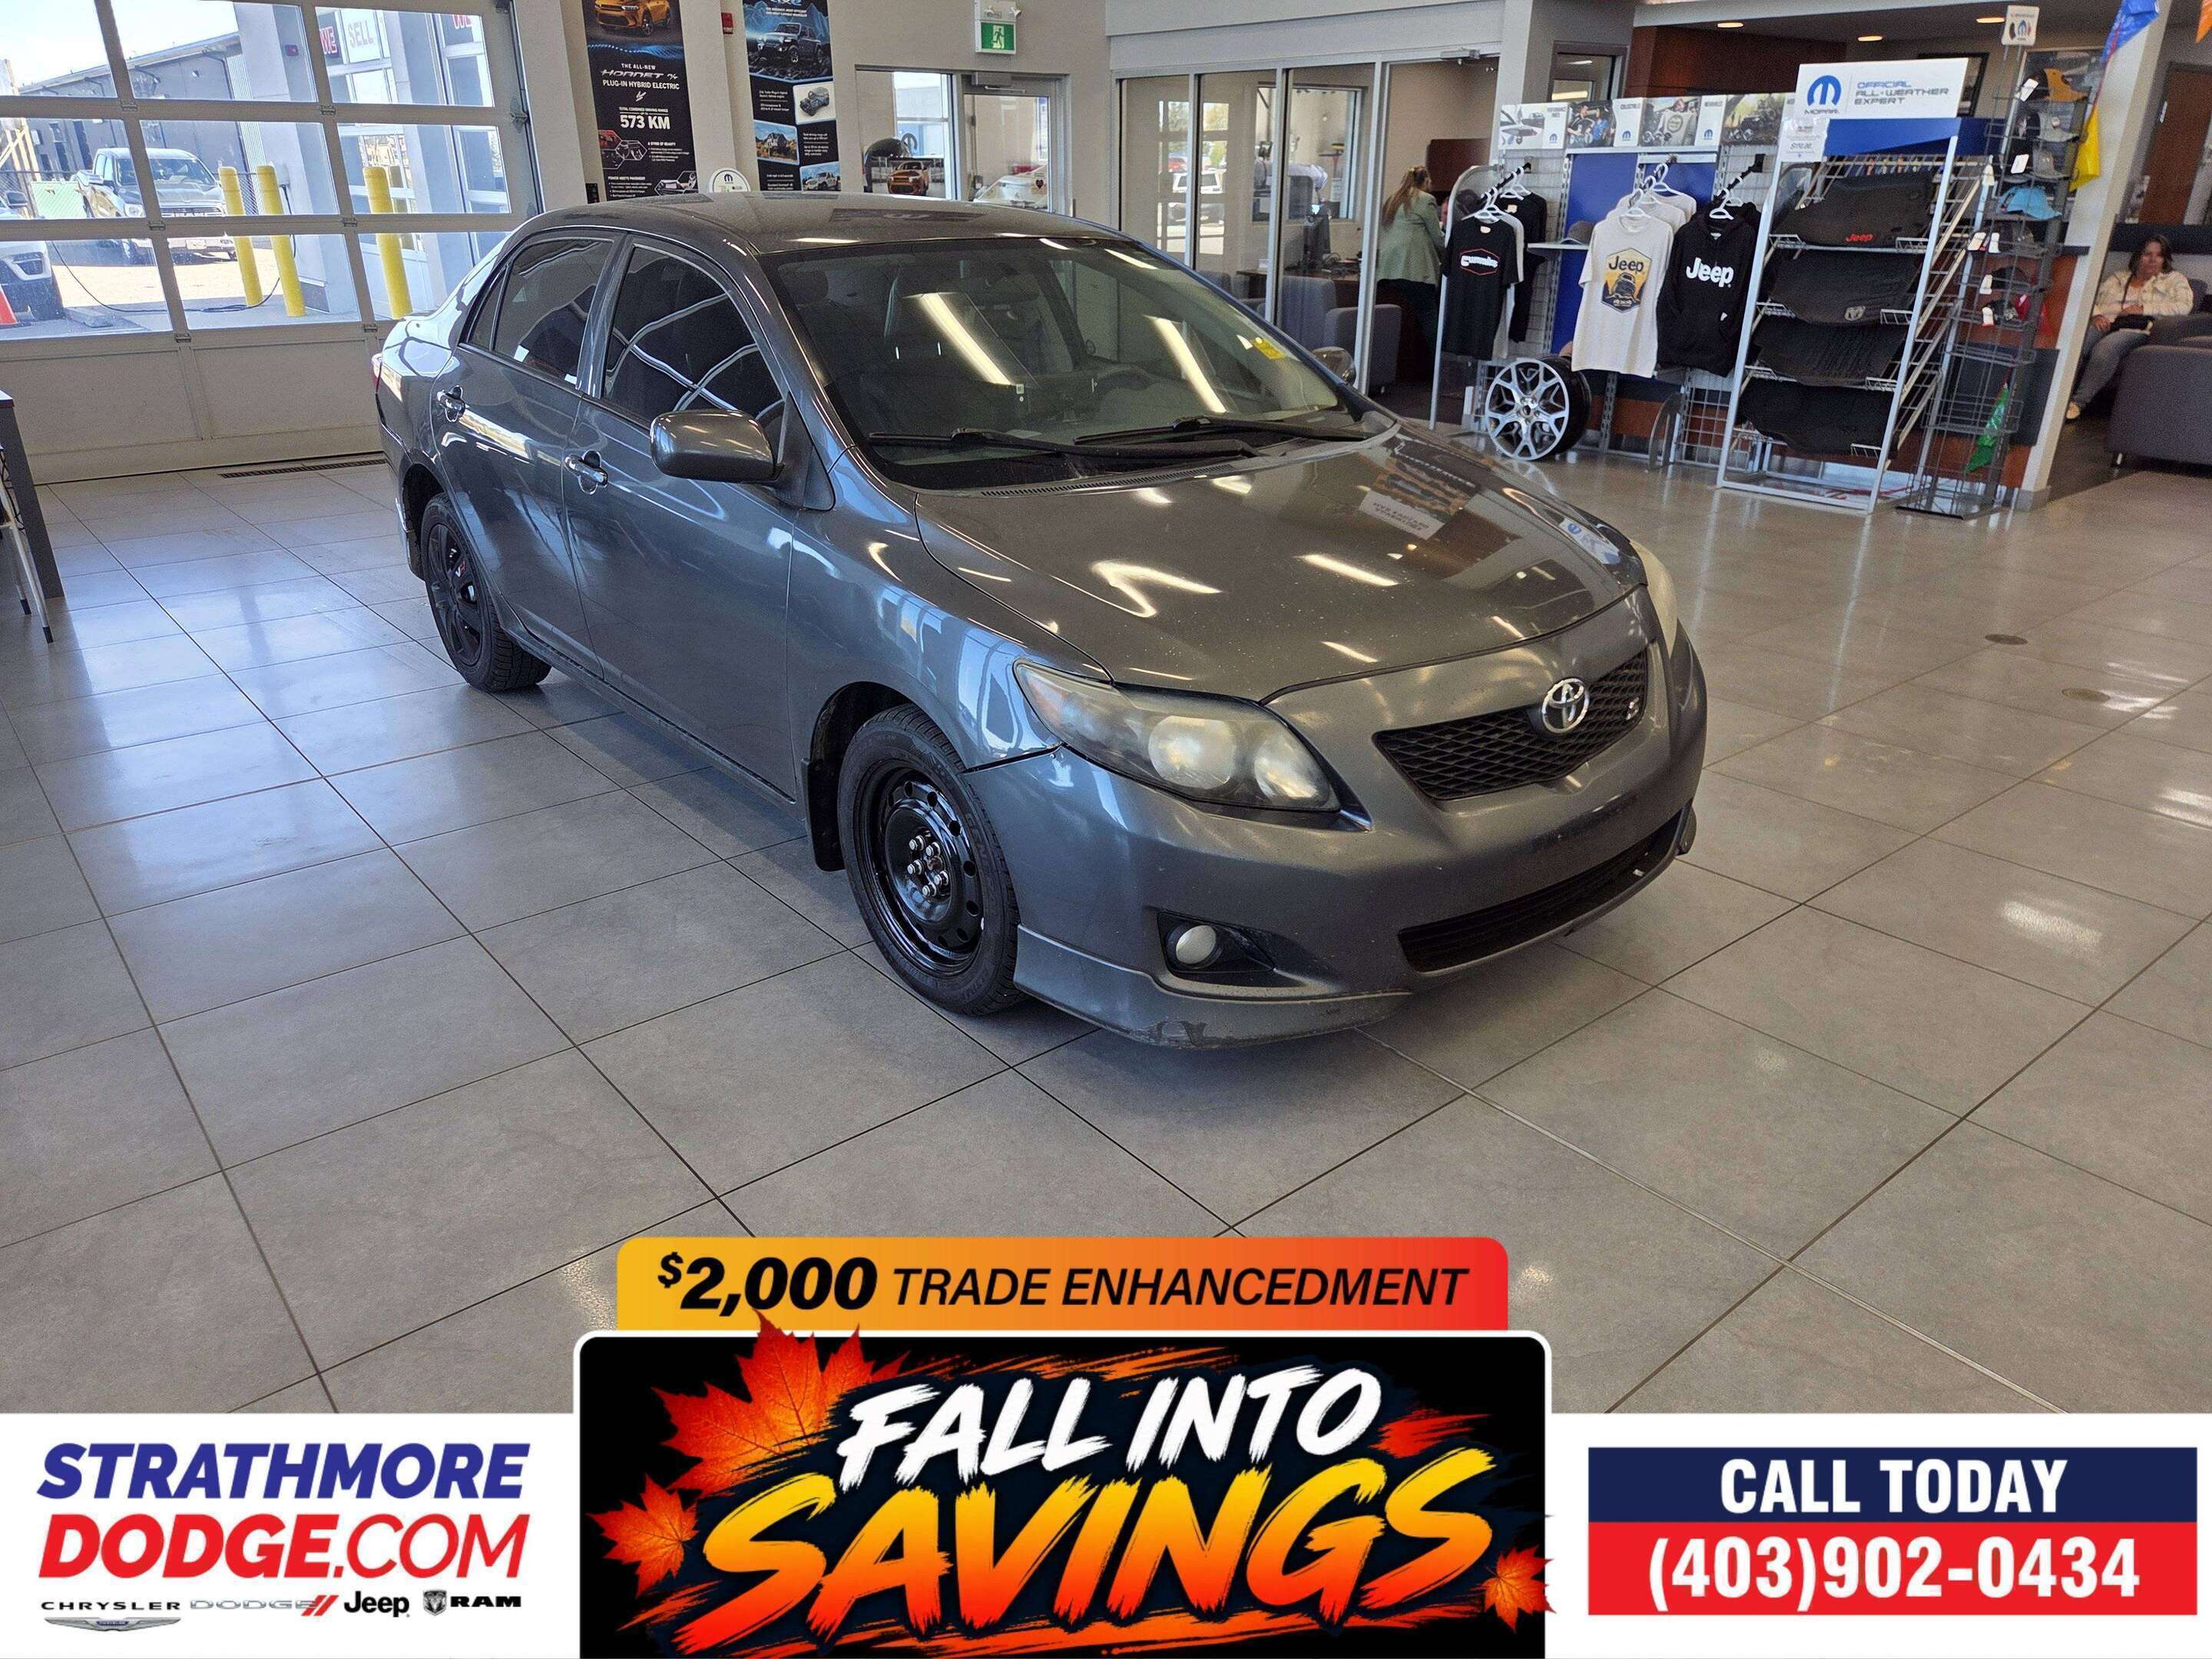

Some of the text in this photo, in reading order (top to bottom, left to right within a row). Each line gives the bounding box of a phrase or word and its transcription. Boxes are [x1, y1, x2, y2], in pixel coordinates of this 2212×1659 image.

[348, 20, 375, 49] SELL
[1857, 81, 1912, 89] OFFICIAL
[1854, 97, 1906, 105] EXPERT
[620, 114, 671, 130] 573 KM
[1608, 256, 1645, 274] Jeep
[1686, 257, 1734, 287] Jeep
